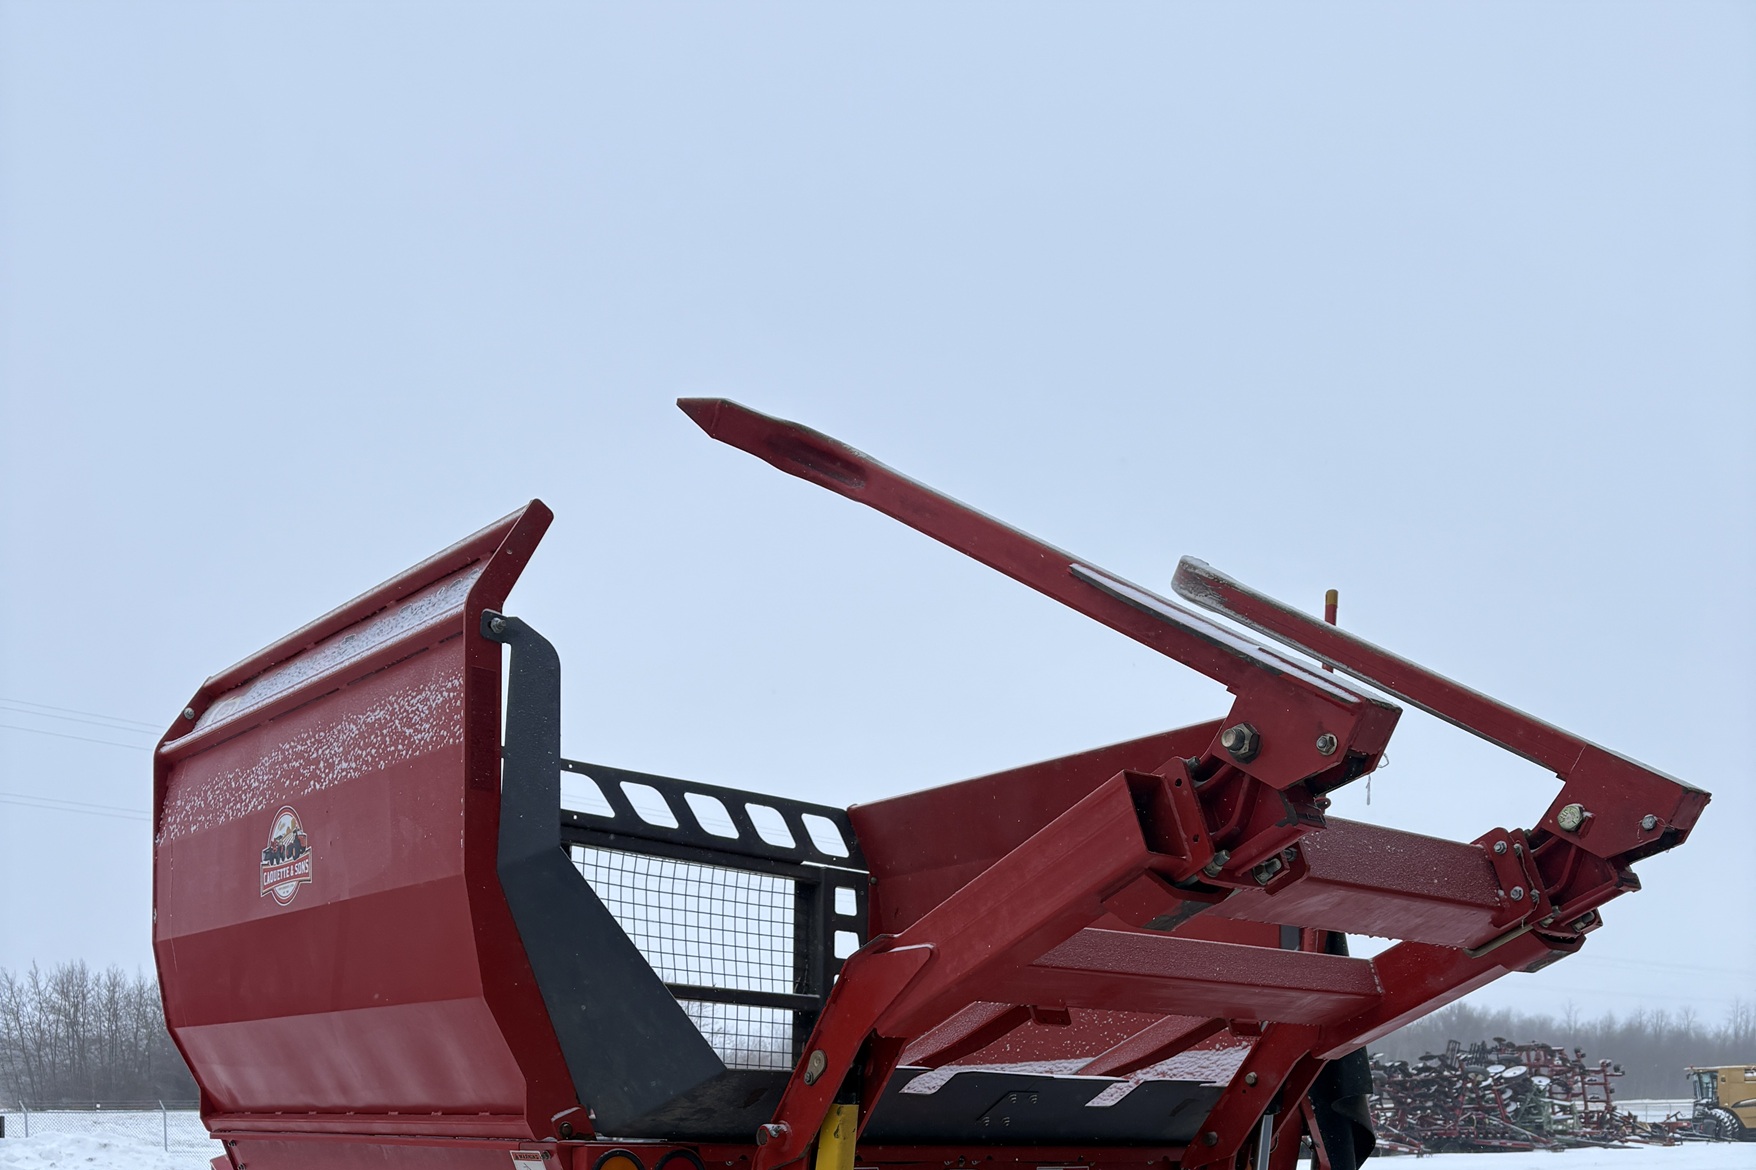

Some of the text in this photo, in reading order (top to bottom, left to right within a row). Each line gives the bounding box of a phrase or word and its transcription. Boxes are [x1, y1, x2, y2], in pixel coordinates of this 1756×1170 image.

[263, 859, 309, 885] CAOUETTE & SONS
